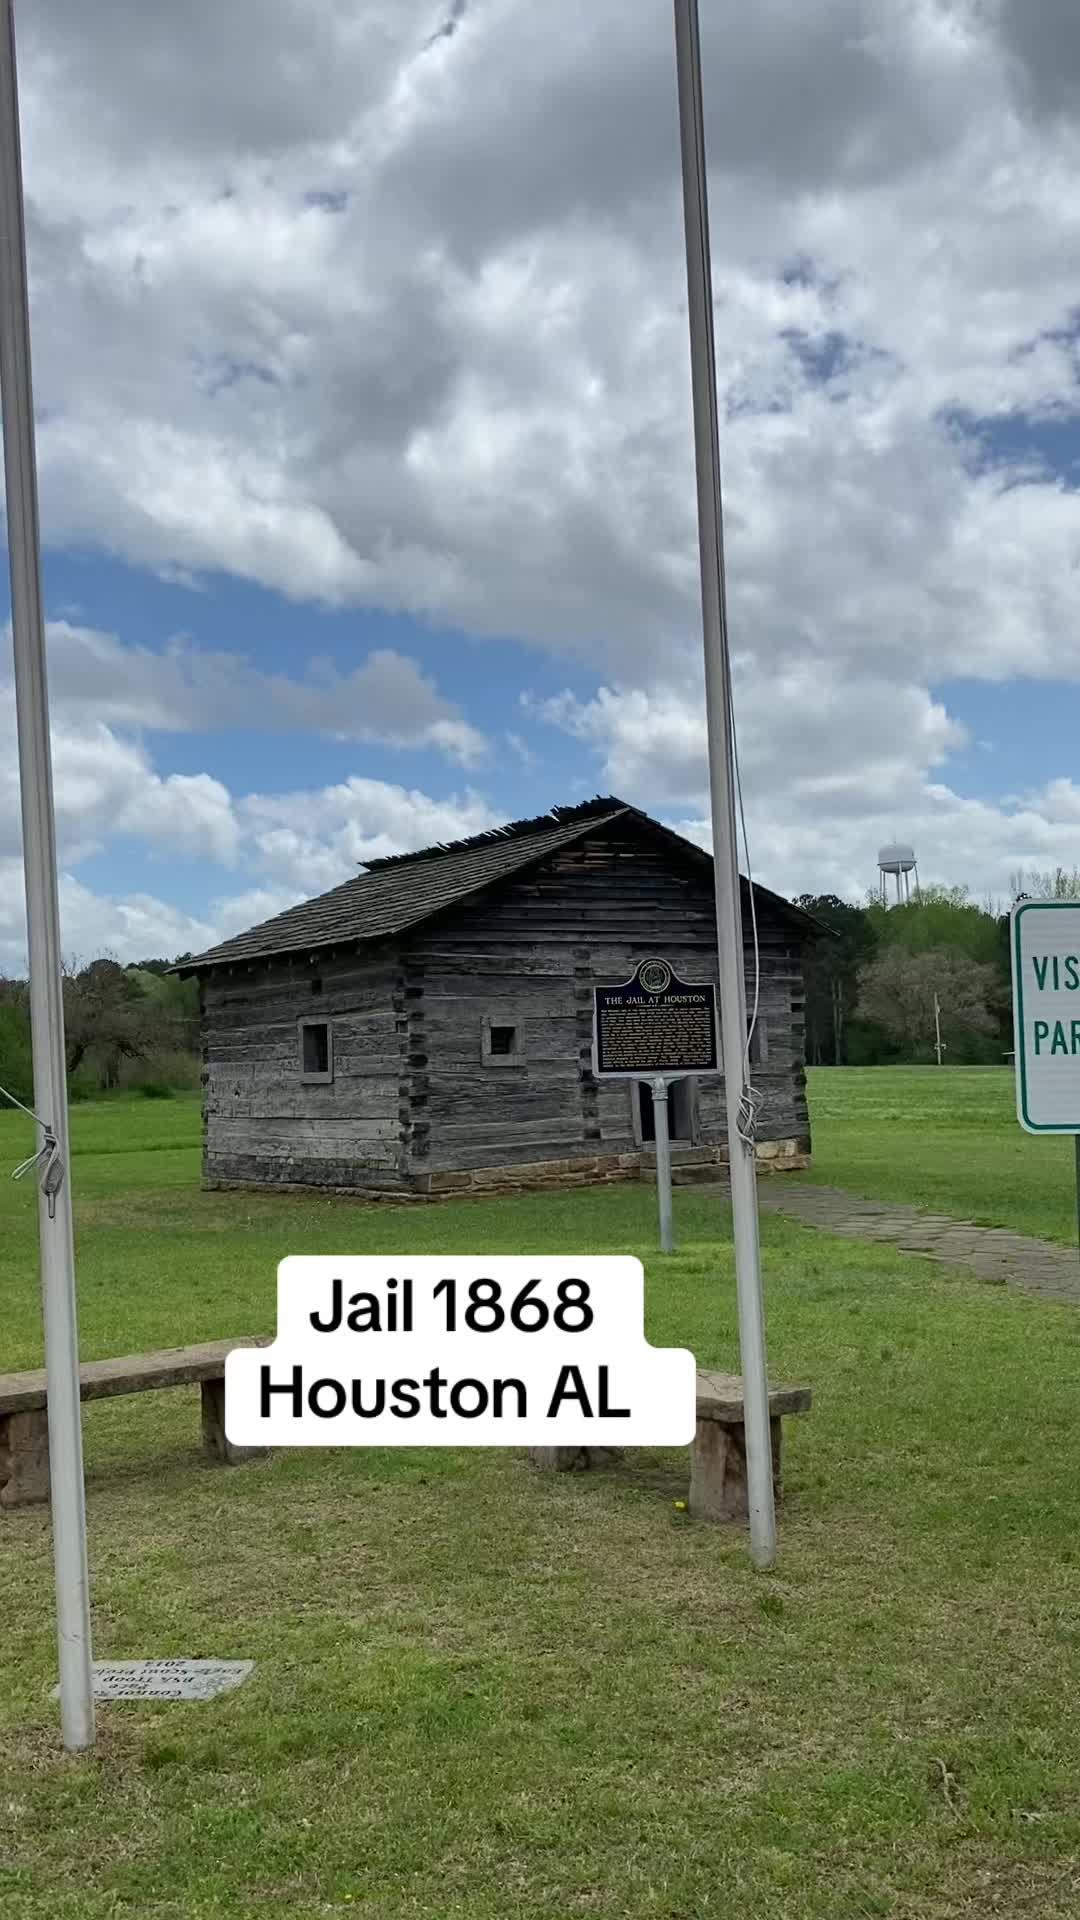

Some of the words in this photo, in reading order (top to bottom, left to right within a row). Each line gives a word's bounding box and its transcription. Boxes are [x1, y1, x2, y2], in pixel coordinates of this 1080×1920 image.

[1032, 956, 1080, 991] VIS
[605, 997, 623, 1005] THE
[626, 996, 646, 1004] JAIL
[648, 995, 661, 1004] AT
[664, 995, 705, 1003] HOUSTON
